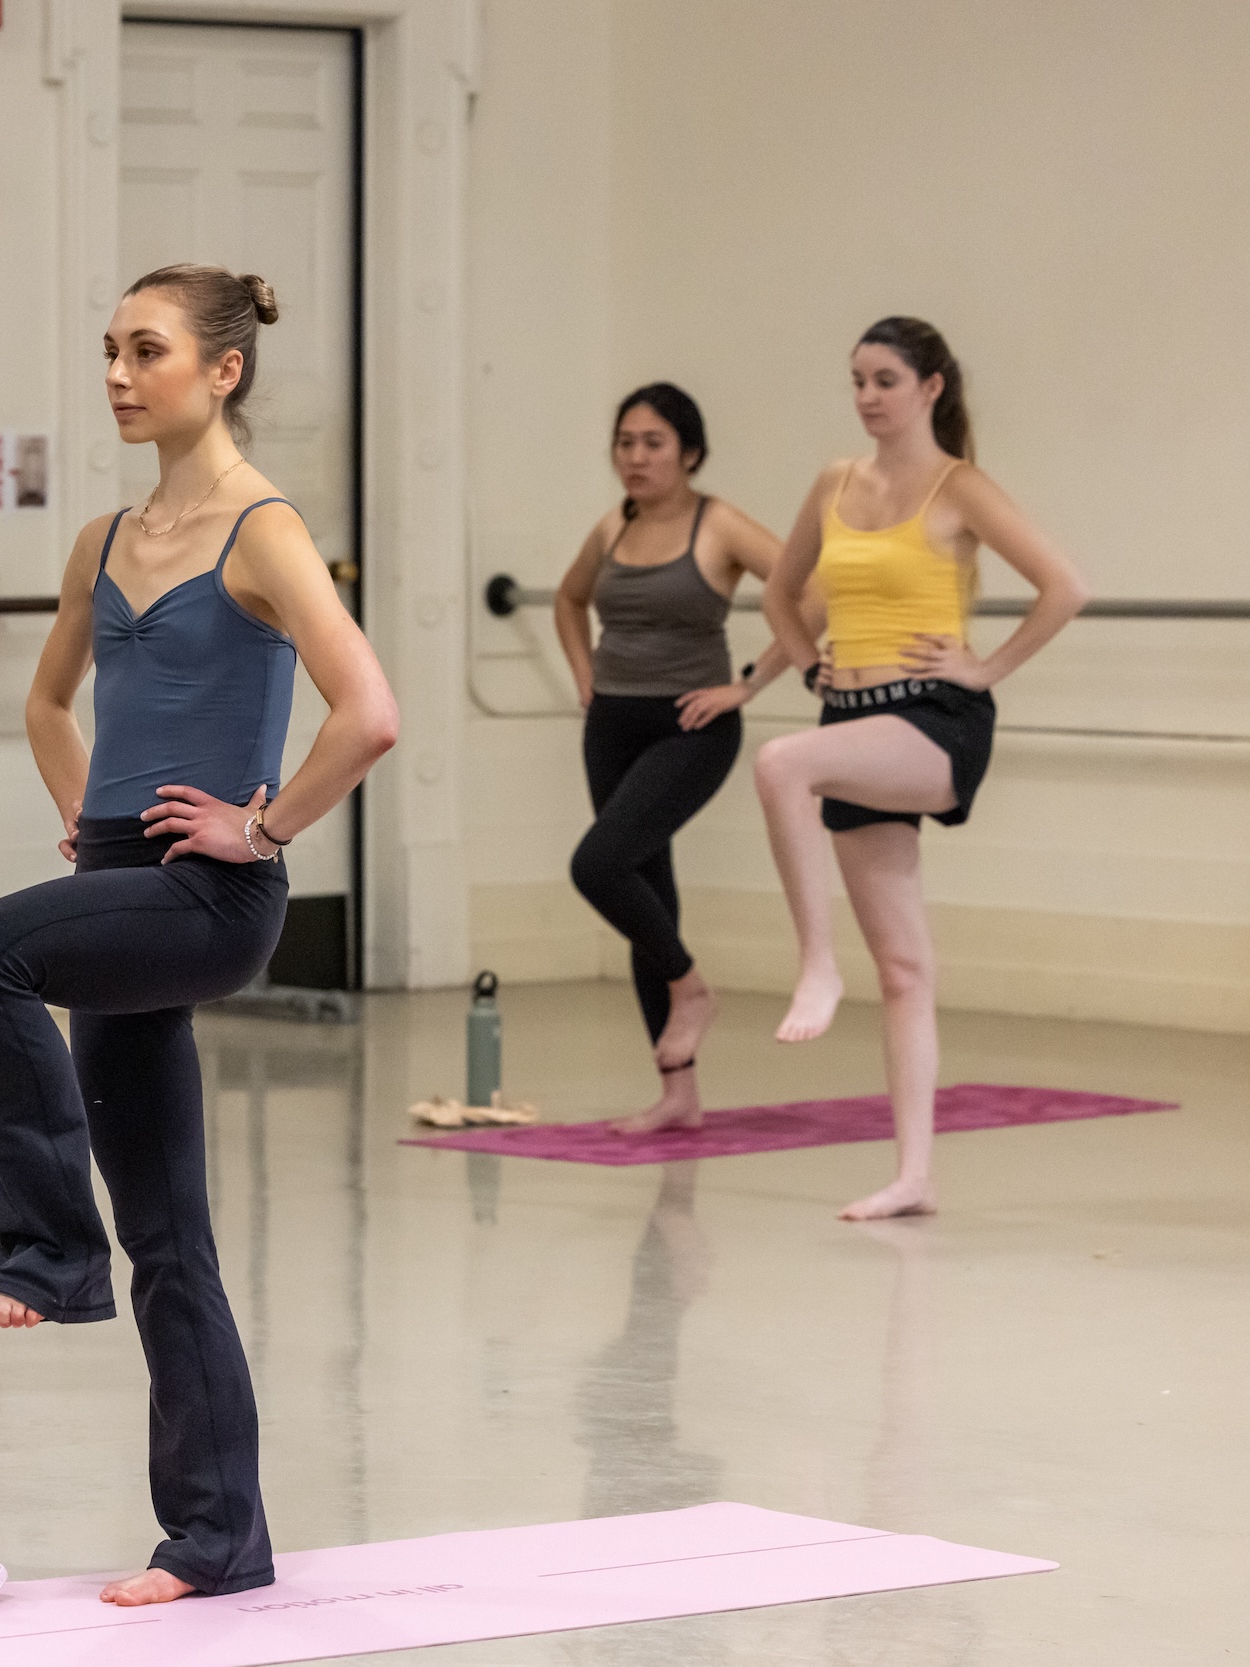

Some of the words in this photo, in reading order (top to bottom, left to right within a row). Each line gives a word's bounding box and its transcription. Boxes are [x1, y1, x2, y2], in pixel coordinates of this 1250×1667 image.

[377, 1588, 422, 1596] in
[416, 1583, 464, 1595] all
[238, 1593, 374, 1613] motion
